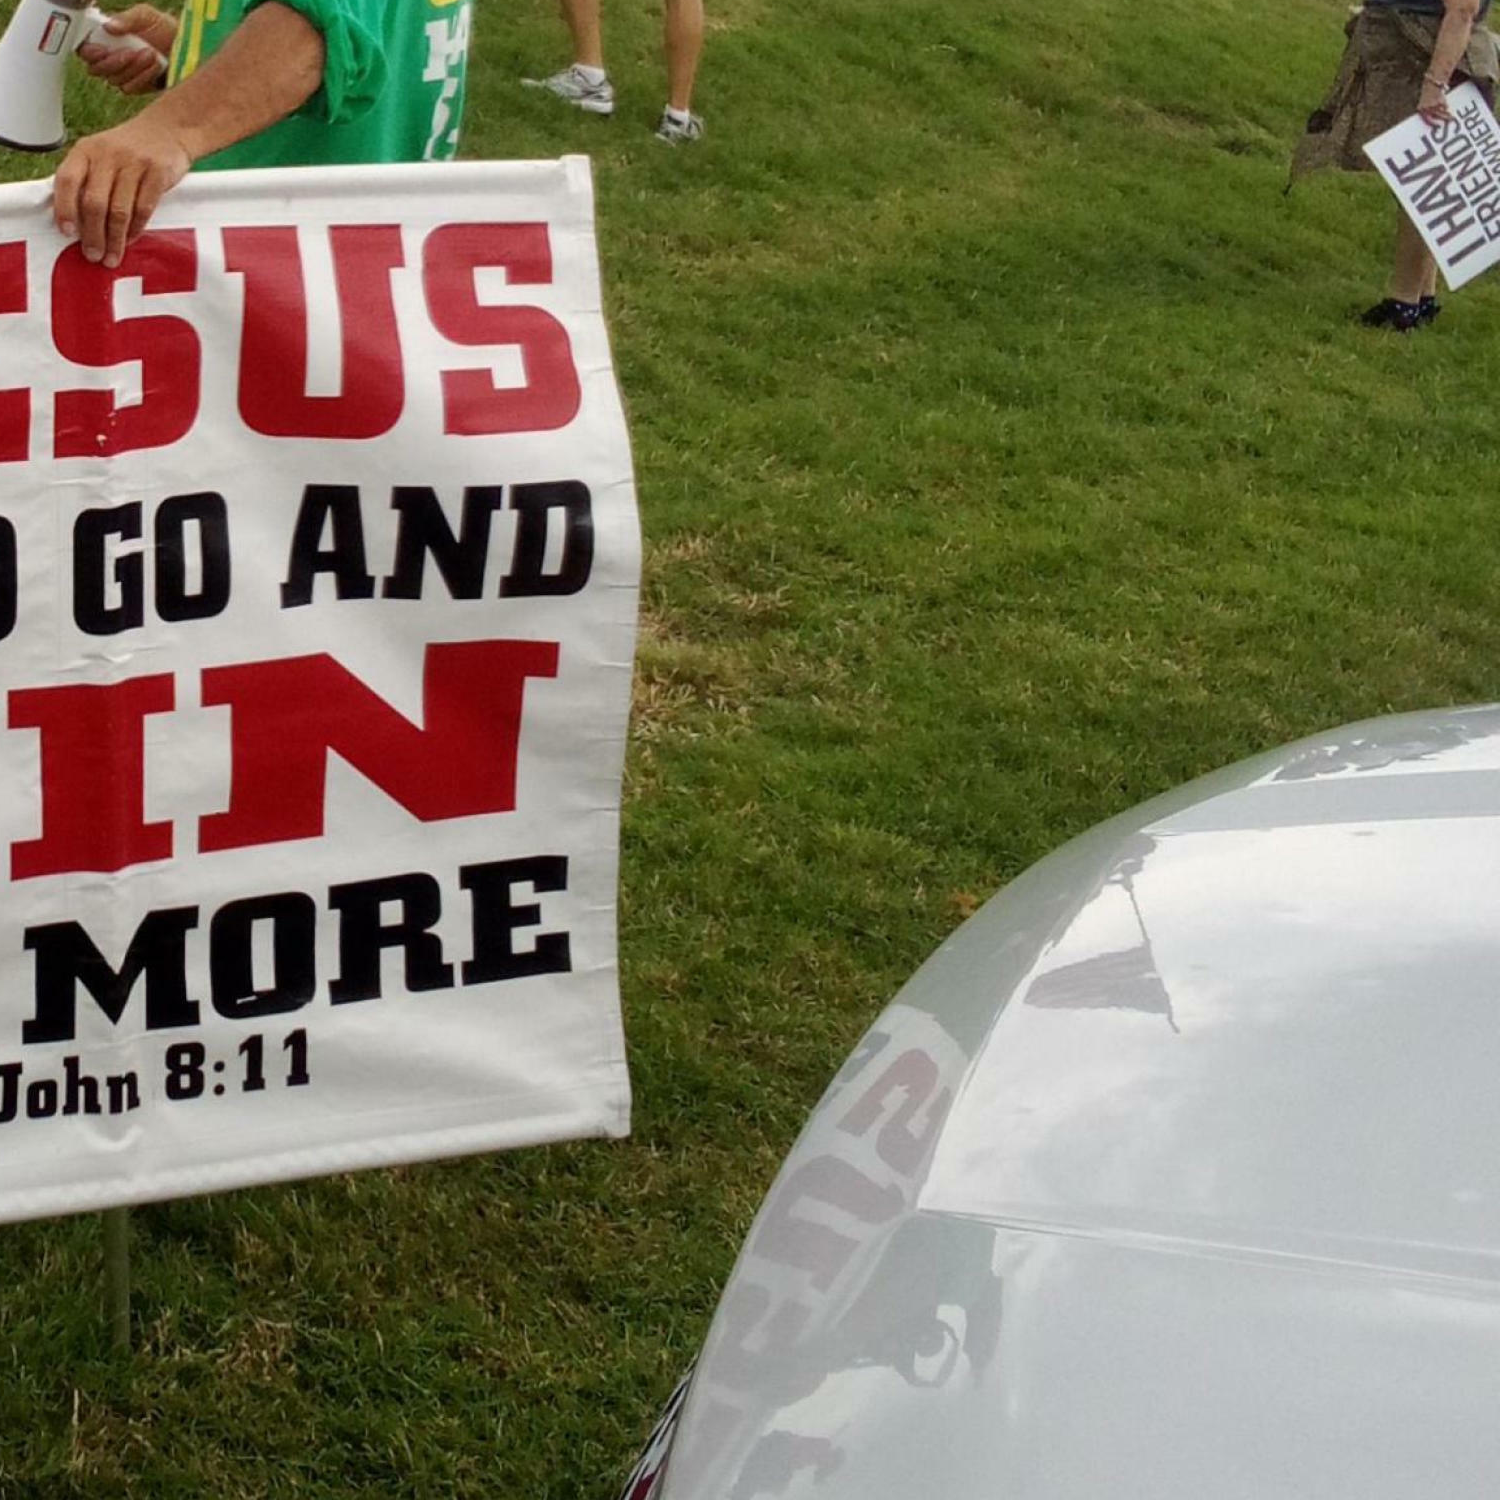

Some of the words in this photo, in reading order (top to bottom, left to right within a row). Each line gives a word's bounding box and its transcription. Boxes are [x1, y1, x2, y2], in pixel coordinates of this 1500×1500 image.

[1384, 133, 1477, 248] HAVE
[1446, 235, 1488, 268] I
[72, 490, 232, 637] GO
[280, 479, 595, 609] AND
[22, 854, 572, 1046] MORE
[164, 1026, 311, 1102] 8:11
